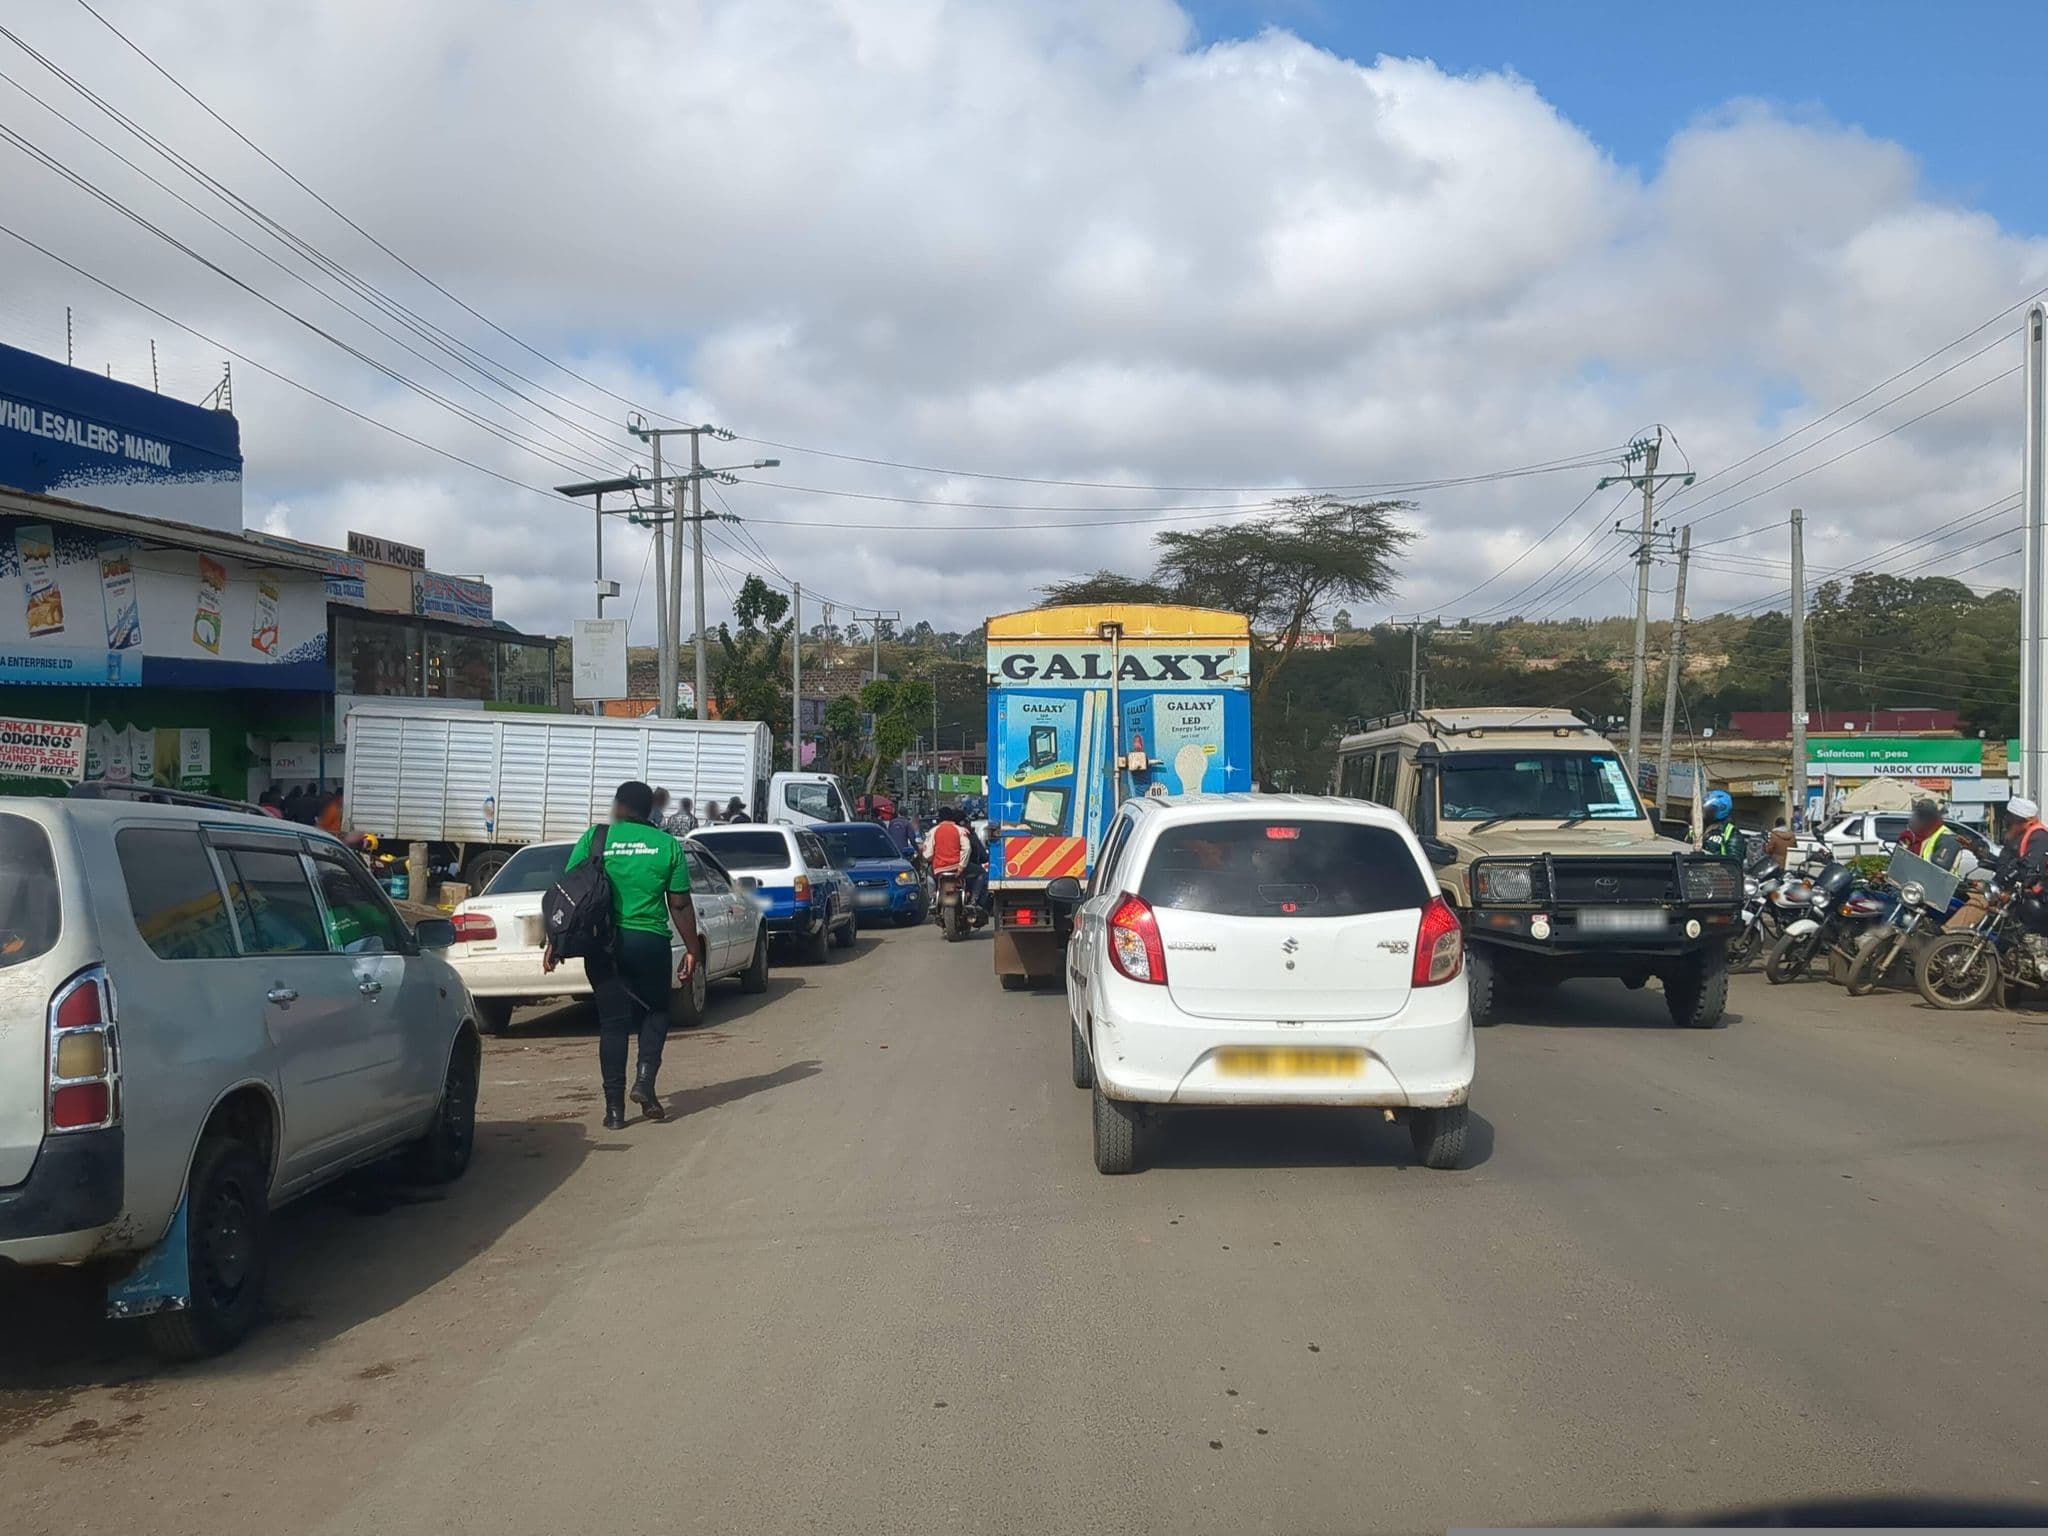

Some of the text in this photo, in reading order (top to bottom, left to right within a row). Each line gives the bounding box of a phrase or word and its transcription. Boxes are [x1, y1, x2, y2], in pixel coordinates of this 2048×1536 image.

[350, 535, 425, 569] MARA HOUSE
[8, 657, 57, 669] ENTERPRISE
[58, 658, 73, 670] LTD
[1001, 654, 1231, 681] GALAXY
[1023, 703, 1066, 713] GALAXY
[1167, 701, 1214, 711] GALAXY
[1182, 717, 1201, 725] LED
[41, 724, 82, 737] PLAZA
[0, 732, 72, 748] ODGINGS
[49, 750, 79, 759] SELF
[1817, 749, 1865, 758] Safaricom
[40, 757, 79, 767] ROOMS
[276, 759, 296, 768] ATM
[15, 763, 37, 771] HOT
[40, 765, 74, 775] WATER
[1873, 765, 1974, 774] NAROK CITY MUSIC
[1151, 787, 1162, 796] 80
[1167, 941, 1216, 951] SUZUKI
[1376, 940, 1409, 949] ALTO
